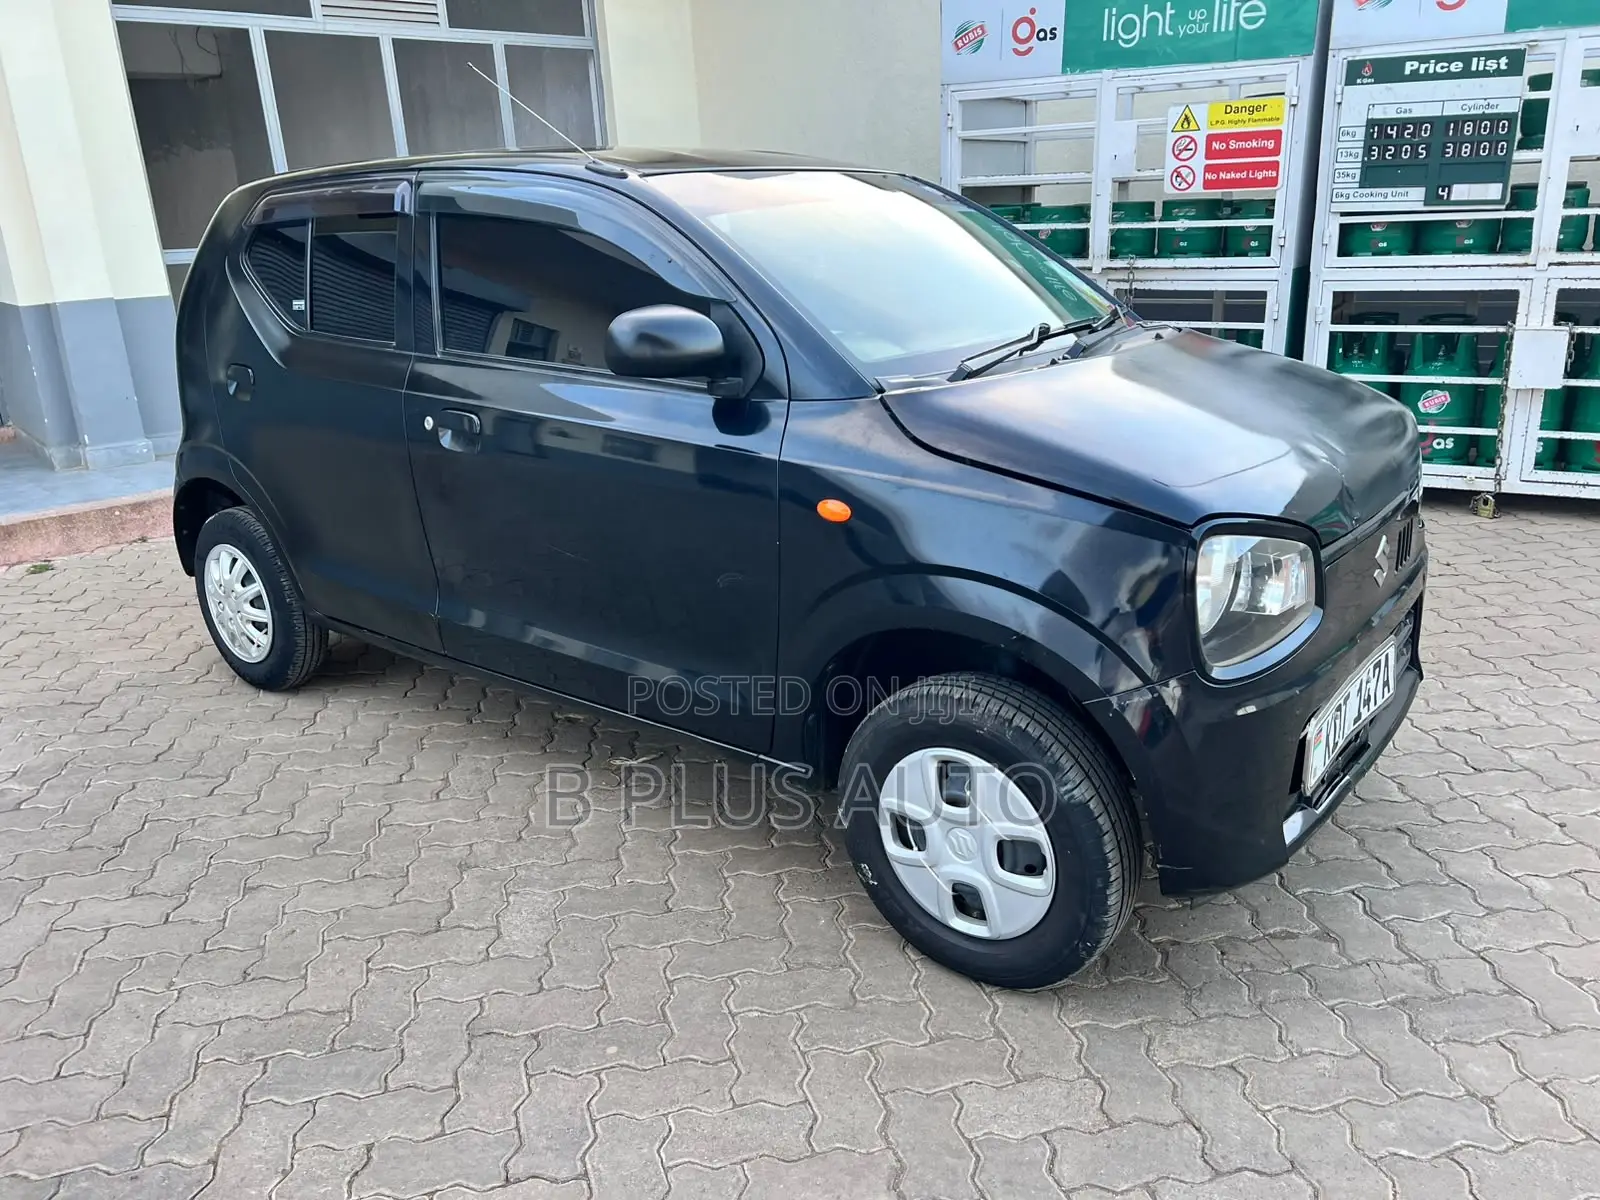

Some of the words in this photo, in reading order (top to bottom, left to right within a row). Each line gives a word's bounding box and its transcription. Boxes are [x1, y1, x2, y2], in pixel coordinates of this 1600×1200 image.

[1188, 8, 1208, 23] up
[1212, 0, 1267, 33] life
[1011, 7, 1058, 57] gas
[1102, 1, 1176, 48] light
[1178, 22, 1210, 39] your
[956, 26, 984, 48] RUBIS
[1403, 59, 1464, 76] Price
[1470, 56, 1509, 72] list
[1224, 103, 1268, 115] Danger
[1395, 106, 1413, 115] Gas
[1460, 102, 1500, 112] Cylinder
[1227, 118, 1247, 126] Highly
[1247, 116, 1281, 124] Flammable
[1341, 129, 1357, 139] 6kg
[1372, 123, 1431, 139] 1420
[1448, 120, 1509, 136] 1800
[1211, 141, 1227, 151] No
[1228, 138, 1275, 150] Smoking
[1339, 151, 1360, 160] 13kg
[1370, 143, 1427, 160] 3205
[1443, 141, 1508, 158] 3800
[1204, 172, 1218, 181] No
[1219, 170, 1248, 180] Naked
[1248, 169, 1277, 180] Lights
[1336, 170, 1357, 181] 35kg
[1335, 191, 1350, 200] 6kg
[1352, 190, 1388, 200] Cooking
[1391, 189, 1410, 198] Unit
[1438, 187, 1449, 200] 4
[1352, 651, 1391, 727] 147A
